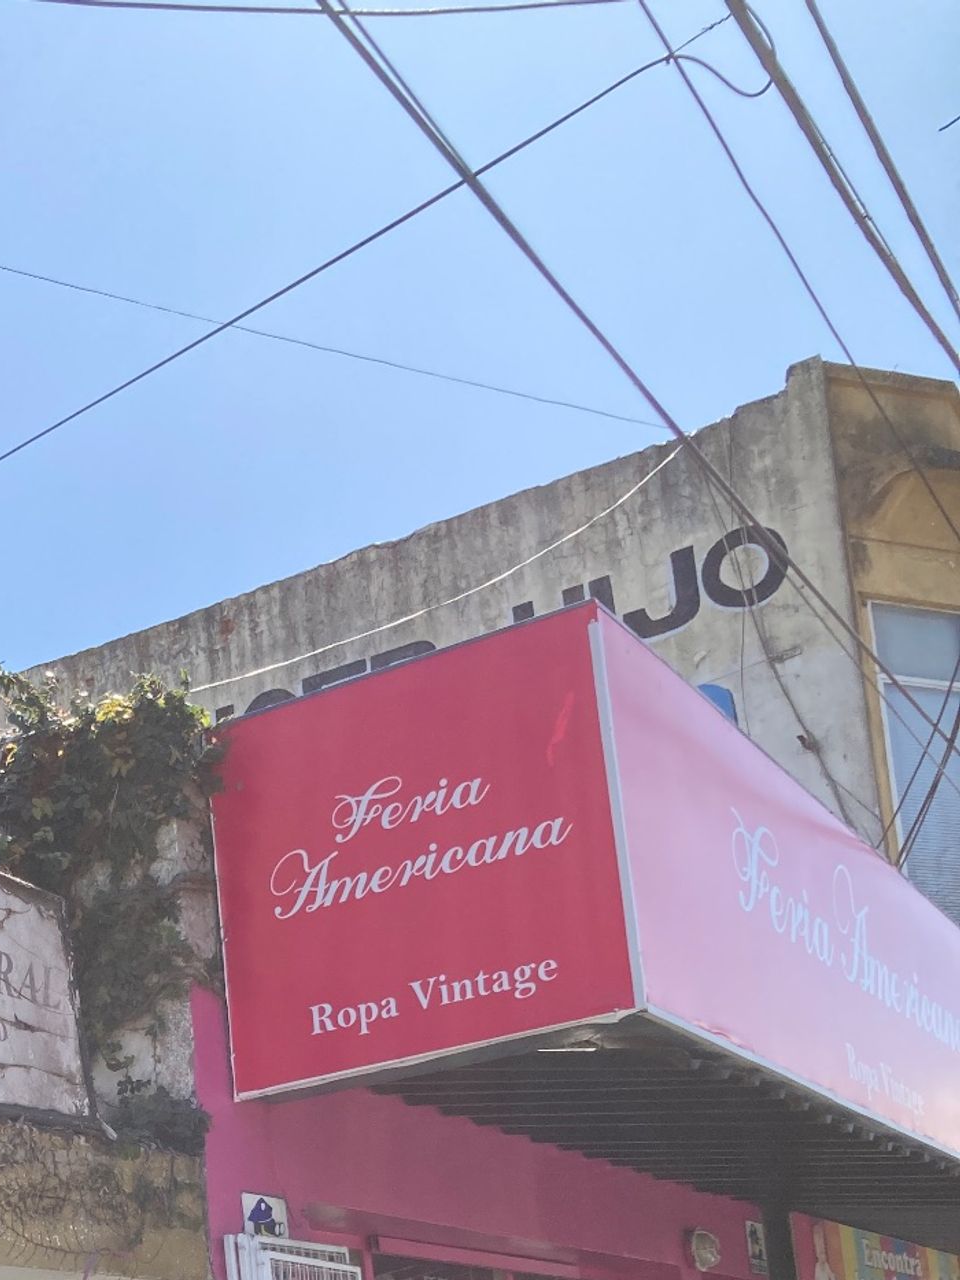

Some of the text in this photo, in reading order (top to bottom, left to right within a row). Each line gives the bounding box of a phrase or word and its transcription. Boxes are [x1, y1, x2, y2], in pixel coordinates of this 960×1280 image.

[513, 526, 788, 640] JO
[332, 773, 491, 844] Feria
[270, 813, 572, 919] Americana
[730, 806, 833, 967] Feria
[309, 957, 559, 1037] Ropa Vintage
